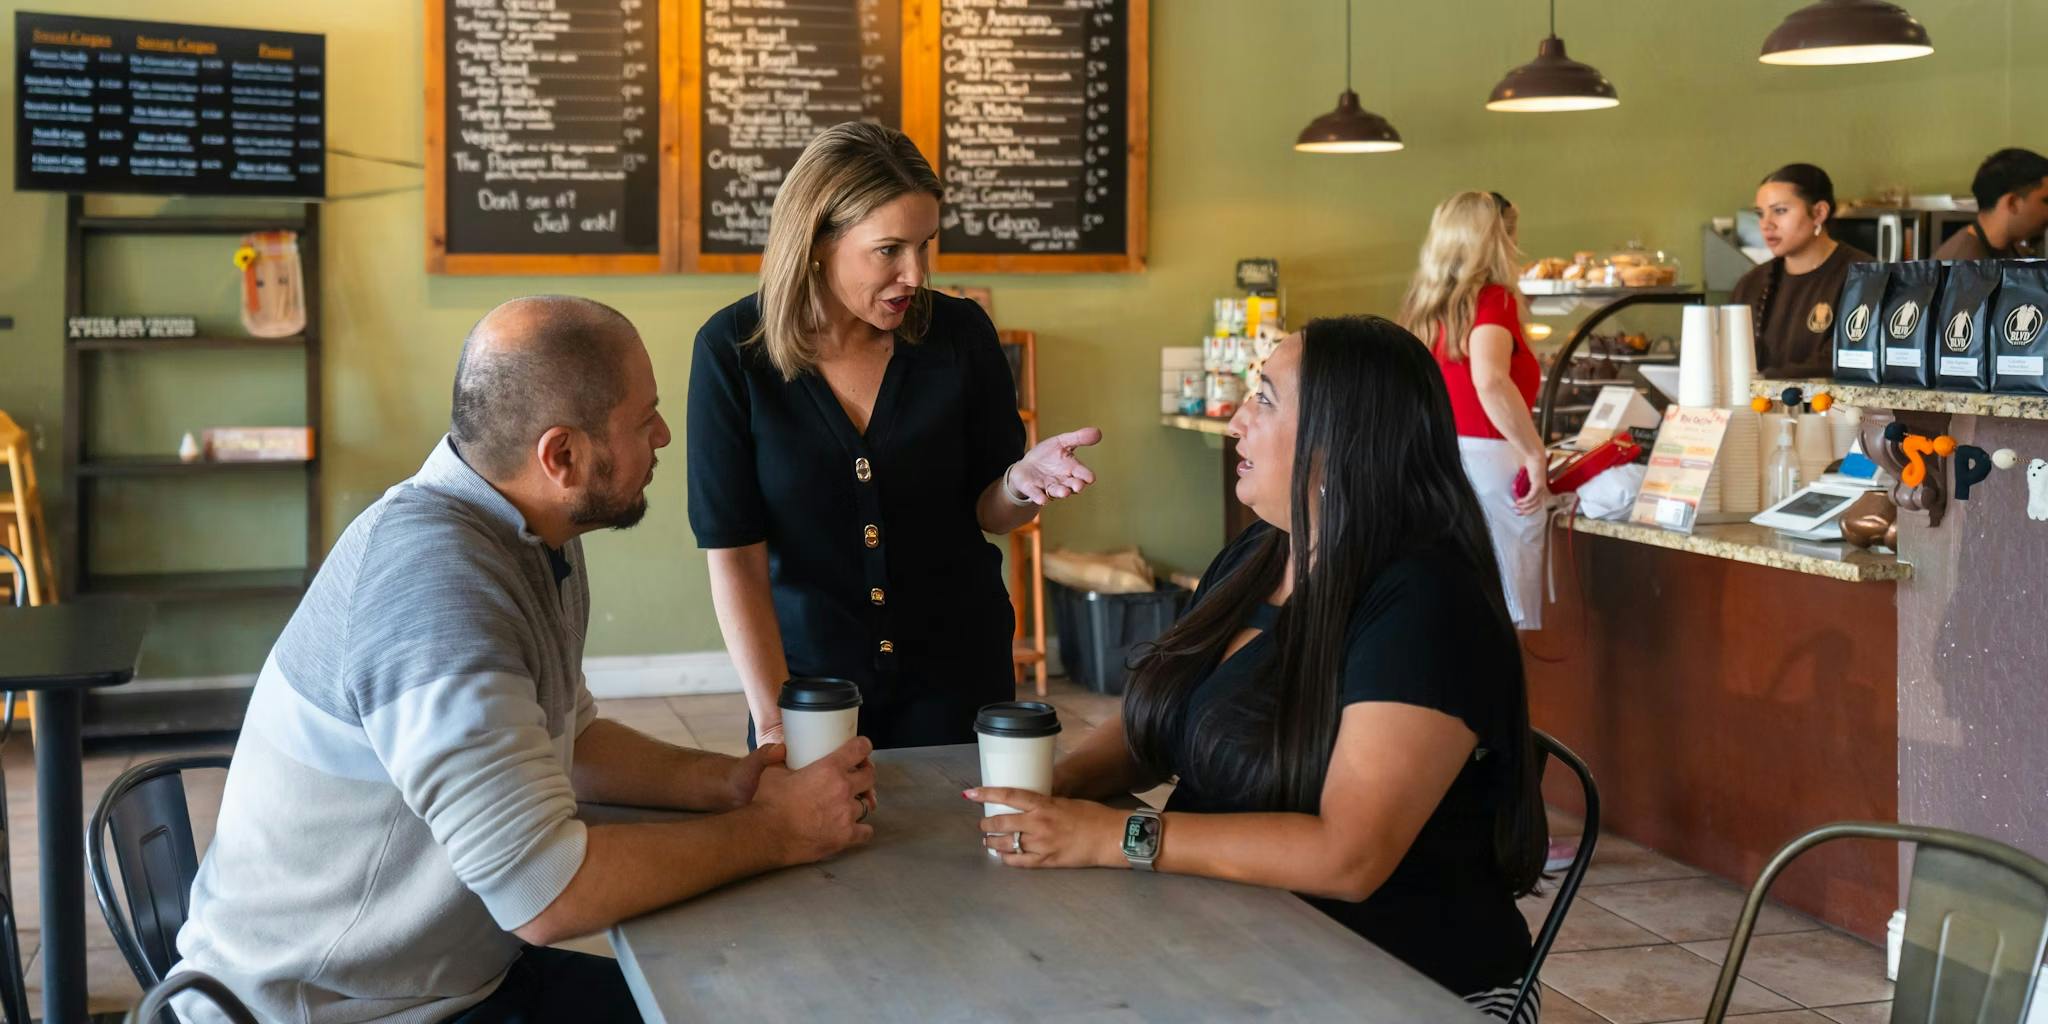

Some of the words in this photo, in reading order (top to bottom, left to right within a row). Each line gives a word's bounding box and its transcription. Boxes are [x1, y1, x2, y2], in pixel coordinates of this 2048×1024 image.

[490, 62, 529, 77] Salad
[453, 151, 481, 172] The
[526, 195, 550, 210] see
[555, 189, 577, 209] it?
[533, 212, 570, 234] Just
[580, 209, 617, 232] ask!
[118, 317, 142, 328] AND
[69, 327, 80, 337] A
[83, 327, 145, 337] PERFECT
[149, 327, 195, 337] BLEND
[2010, 331, 2031, 341] BLVD
[1950, 337, 1966, 348] BLVD
